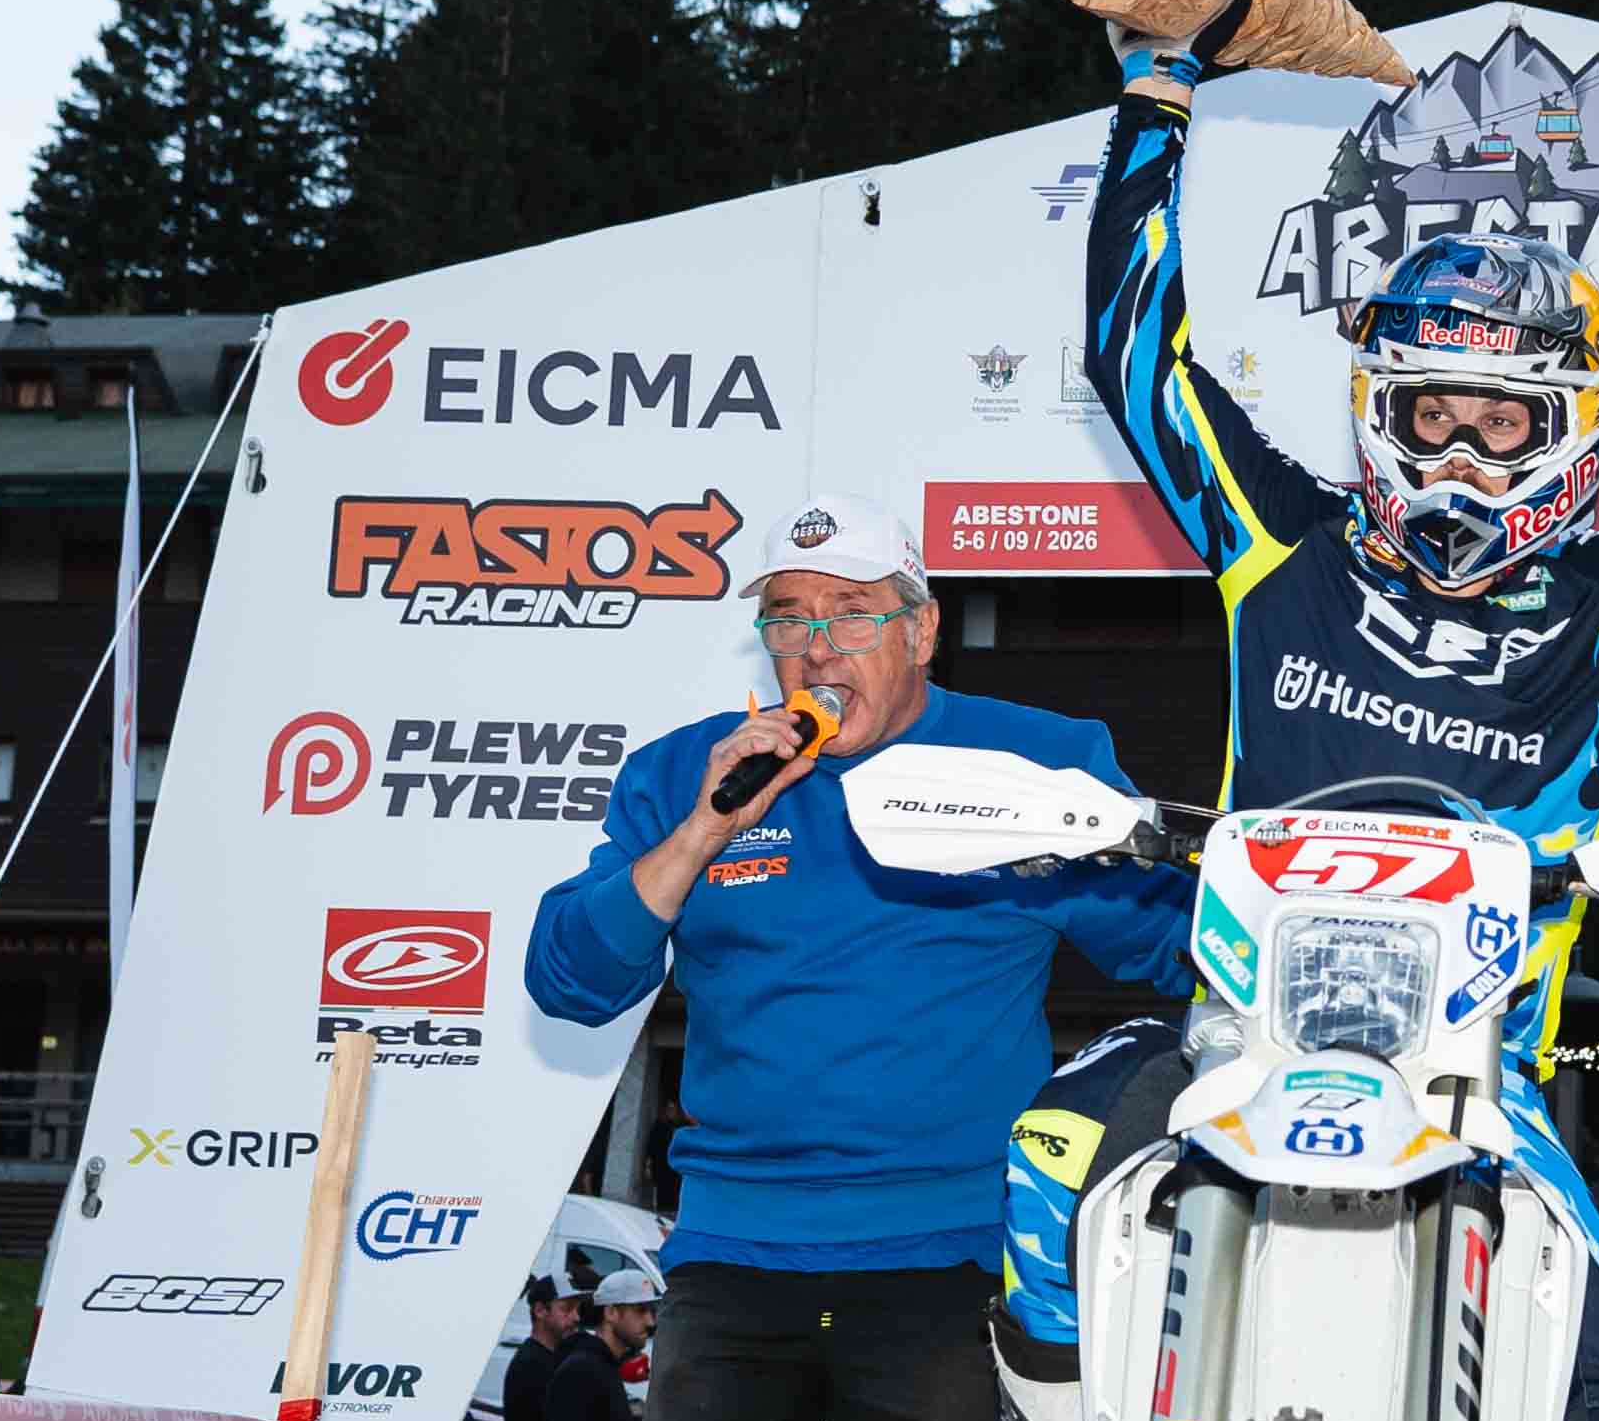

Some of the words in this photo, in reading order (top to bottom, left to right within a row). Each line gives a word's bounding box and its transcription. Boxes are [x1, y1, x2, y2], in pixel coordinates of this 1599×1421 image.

[1419, 319, 1466, 345] Red
[1468, 324, 1516, 352] Bull
[424, 347, 781, 430] EICMA
[952, 505, 1098, 525] ABESTONE
[1502, 471, 1574, 553] Red
[952, 530, 983, 550] 5-6
[988, 531, 1000, 550] /
[1003, 530, 1030, 550] 09
[1034, 531, 1045, 550] /
[1047, 530, 1098, 550] 2026
[402, 582, 643, 628] RACING
[1310, 670, 1544, 765] Husqvarna
[386, 719, 626, 764] PLEWS
[381, 773, 612, 820] TYRES
[1323, 821, 1379, 833] EICMA
[1275, 837, 1460, 897] 57
[1311, 916, 1410, 930] FARIOLI
[1466, 963, 1509, 1004] BOLT
[415, 1193, 484, 1207] Chiaravalli
[374, 1208, 479, 1245] CHT
[333, 1402, 392, 1415] STRONGER
